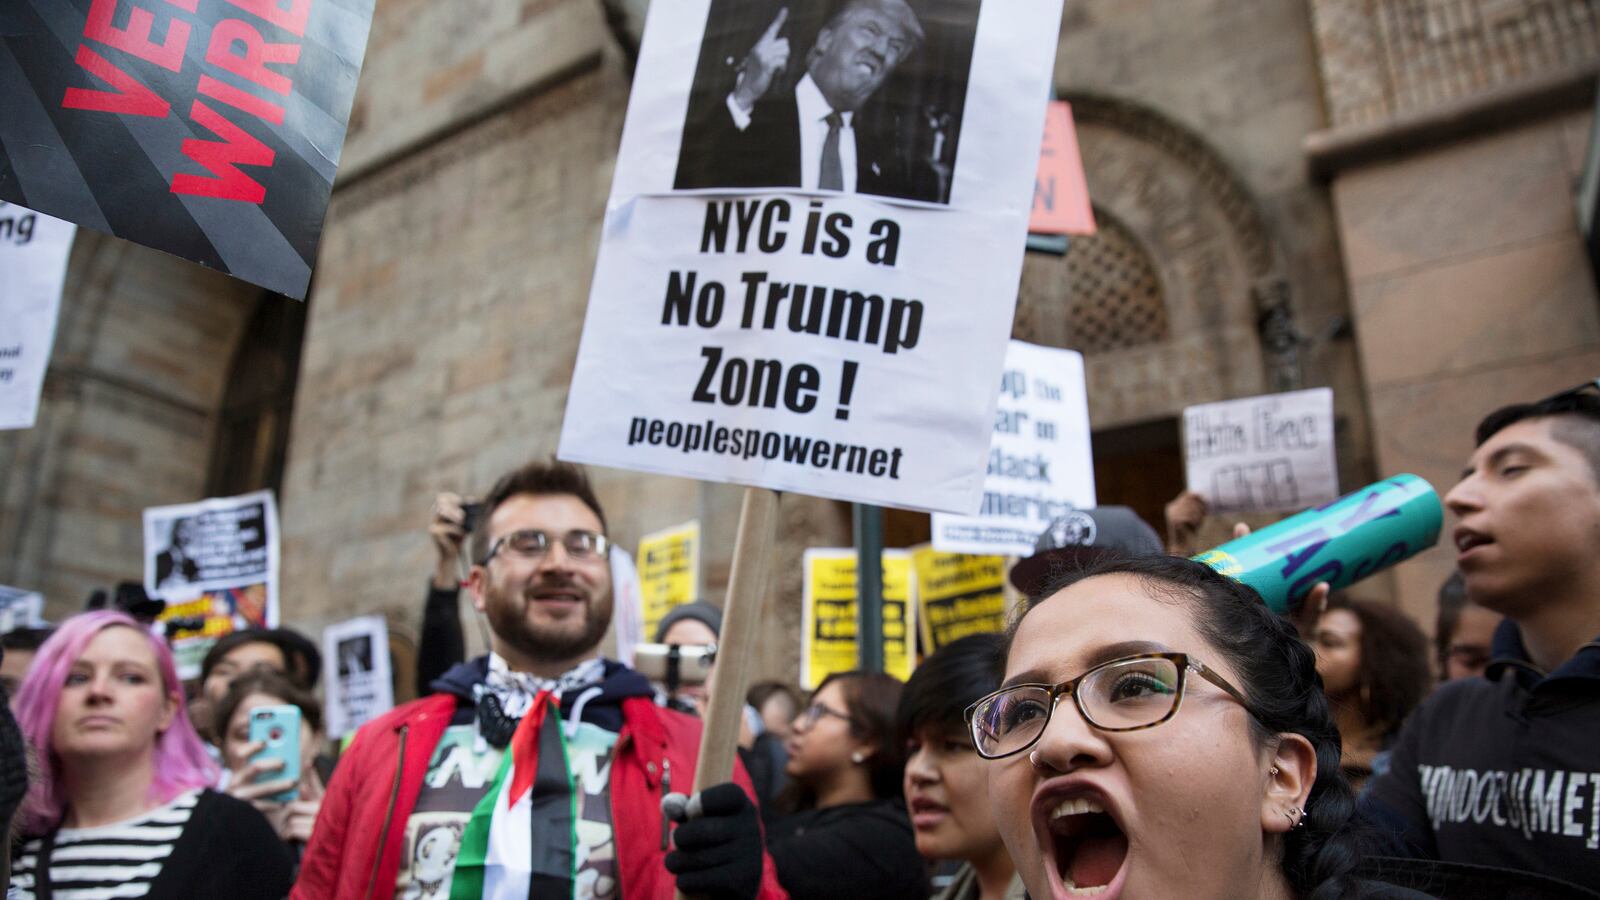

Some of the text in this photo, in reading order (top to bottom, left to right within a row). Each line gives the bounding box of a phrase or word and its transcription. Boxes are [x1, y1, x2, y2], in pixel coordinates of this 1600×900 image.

[700, 198, 901, 266] NYC is a
[661, 271, 924, 354] No Trump
[692, 346, 859, 421] Zone !
[628, 416, 903, 479] peoplespowernet
